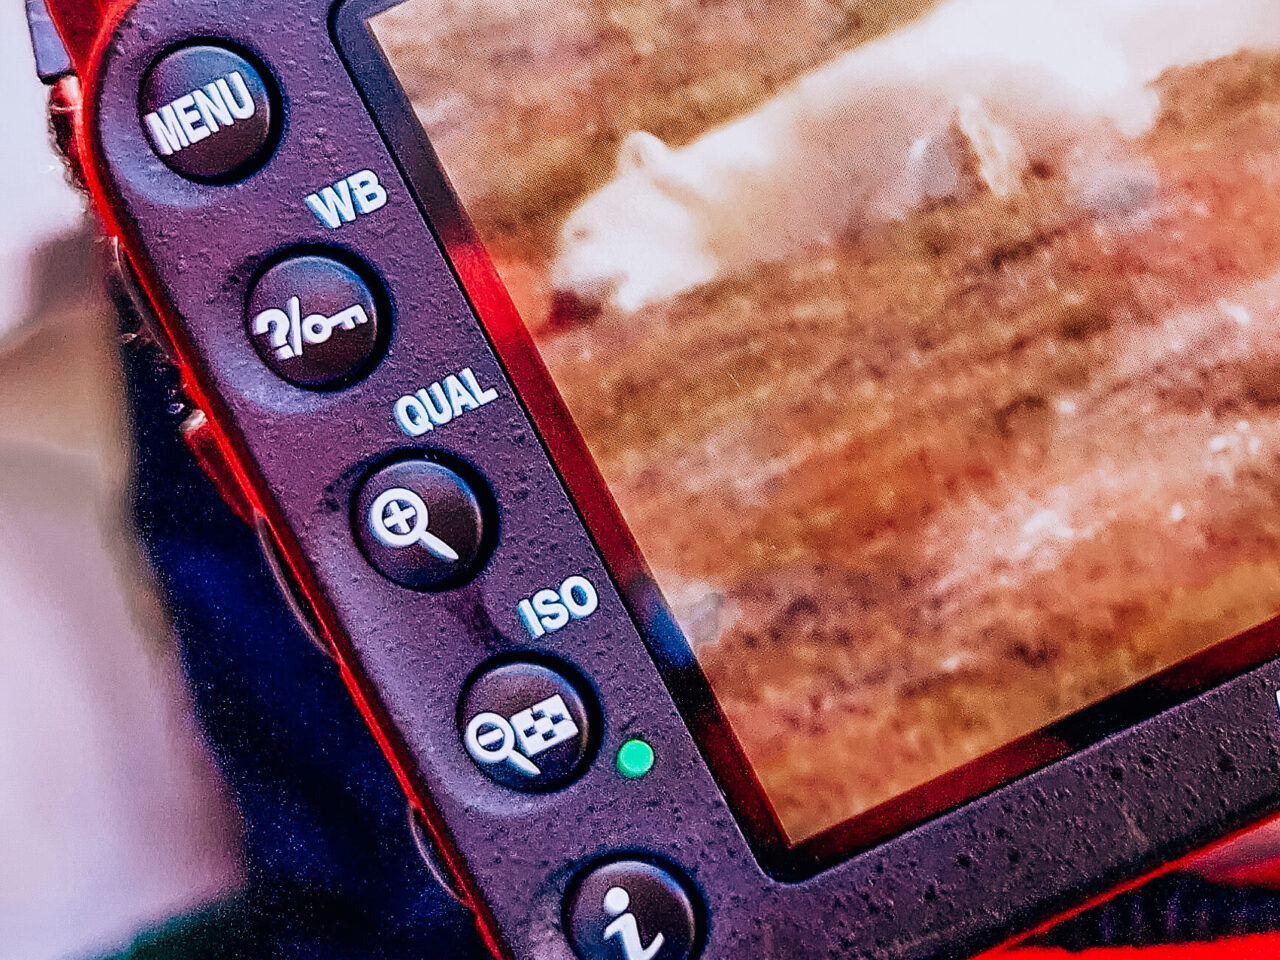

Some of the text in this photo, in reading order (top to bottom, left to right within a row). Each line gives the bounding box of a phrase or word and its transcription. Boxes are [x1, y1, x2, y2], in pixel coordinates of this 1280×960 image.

[145, 71, 256, 156] MENU
[306, 169, 389, 230] WB
[393, 366, 499, 438] QUAL
[516, 574, 600, 639] ISO
[602, 886, 667, 960] i
